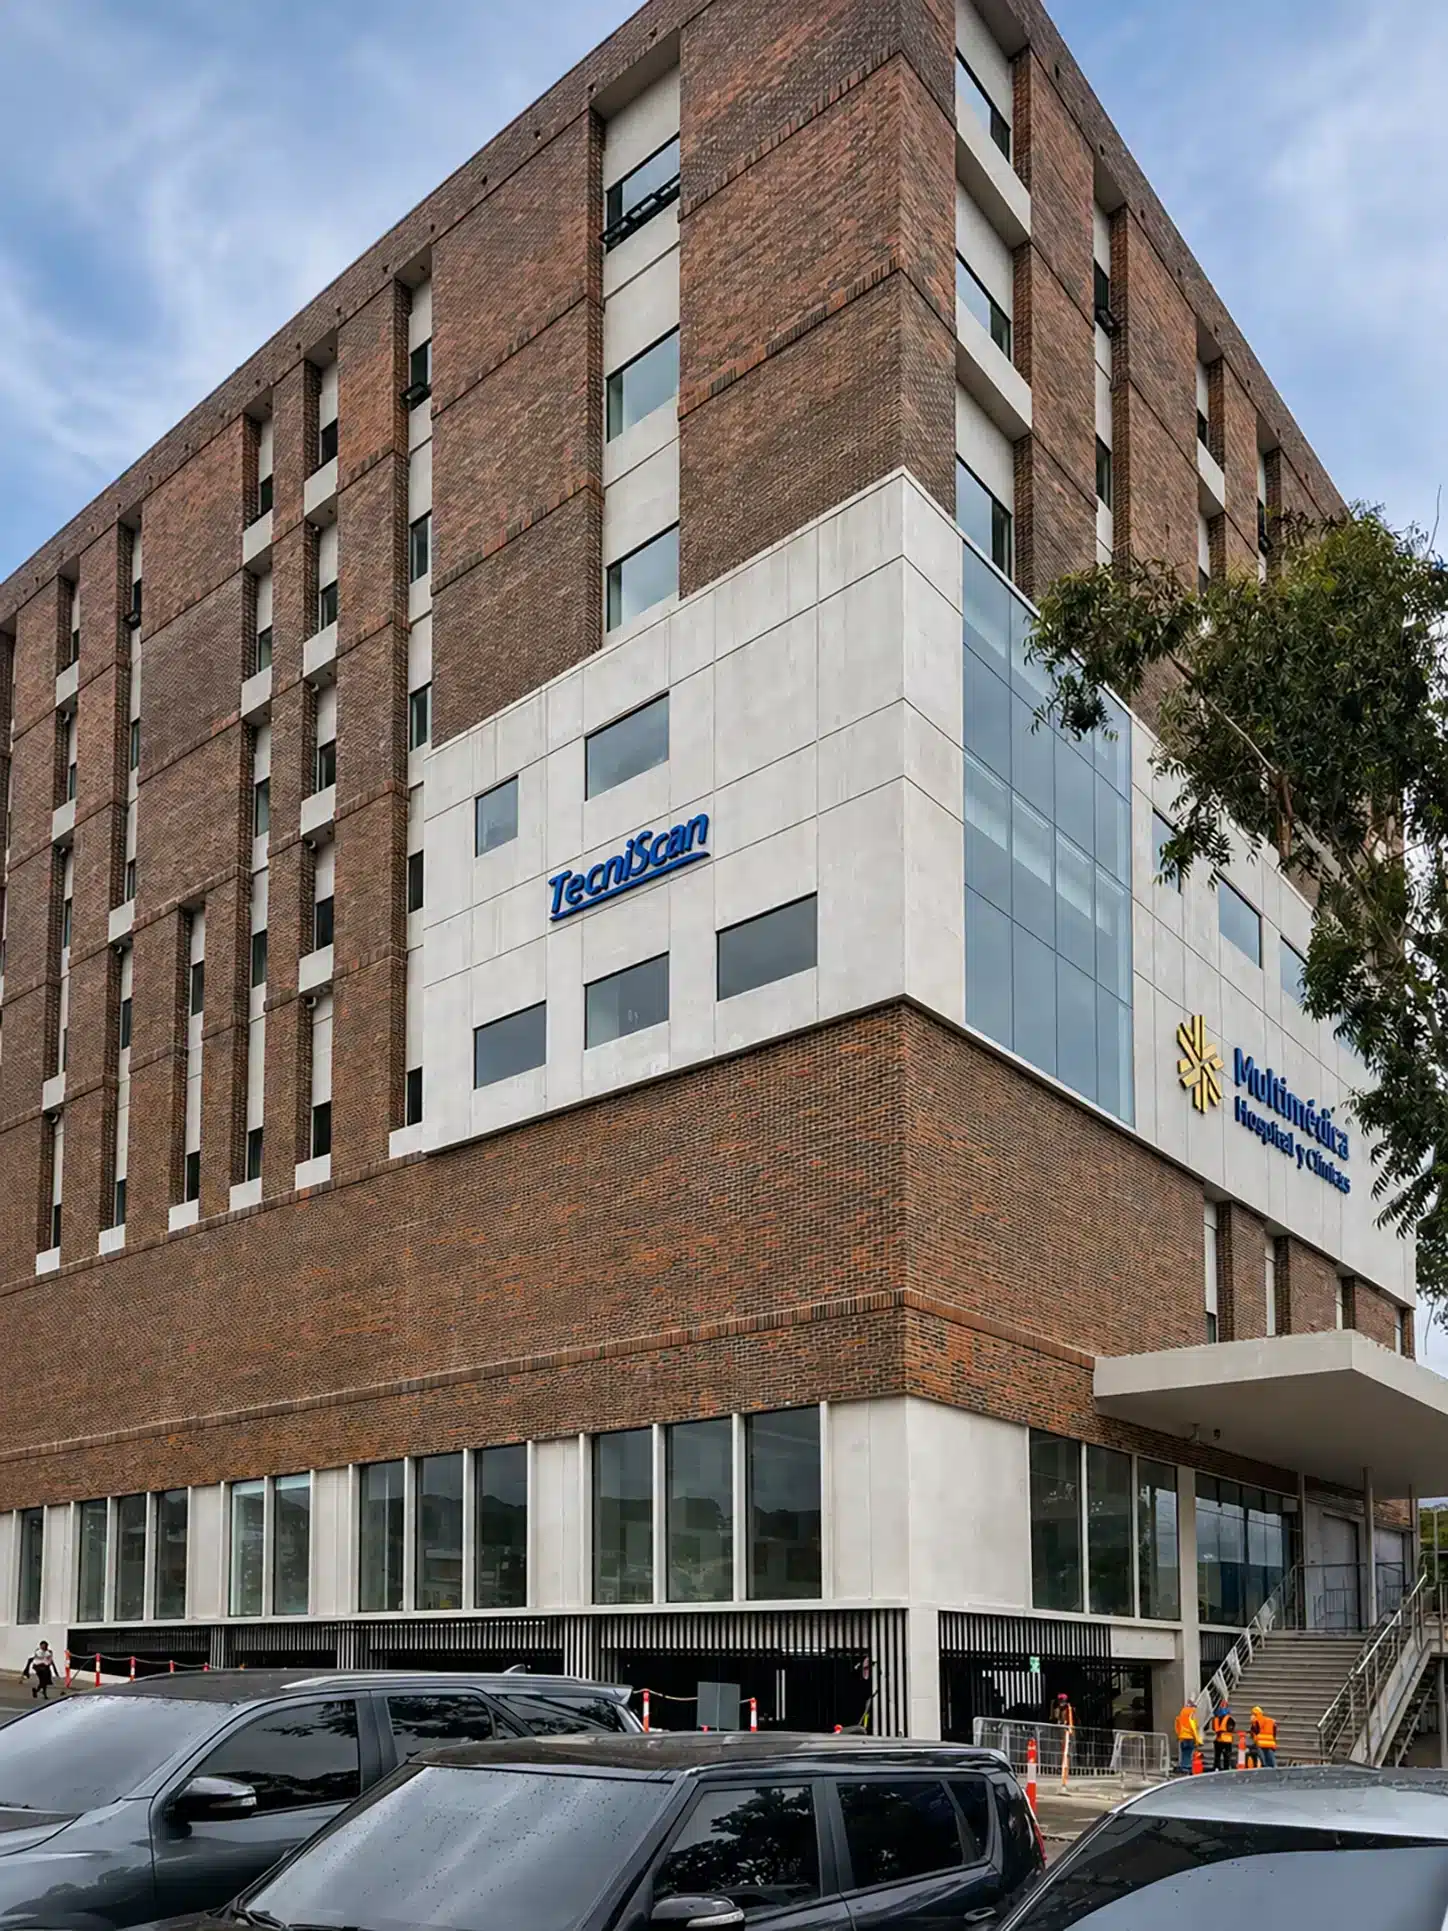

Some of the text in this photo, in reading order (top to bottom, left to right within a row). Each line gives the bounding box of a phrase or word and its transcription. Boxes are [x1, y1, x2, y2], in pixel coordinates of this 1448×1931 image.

[548, 813, 710, 915] TecniScan
[1234, 1048, 1349, 1161] Multimédica
[1234, 1095, 1295, 1158] Hospital
[1295, 1144, 1306, 1169] y
